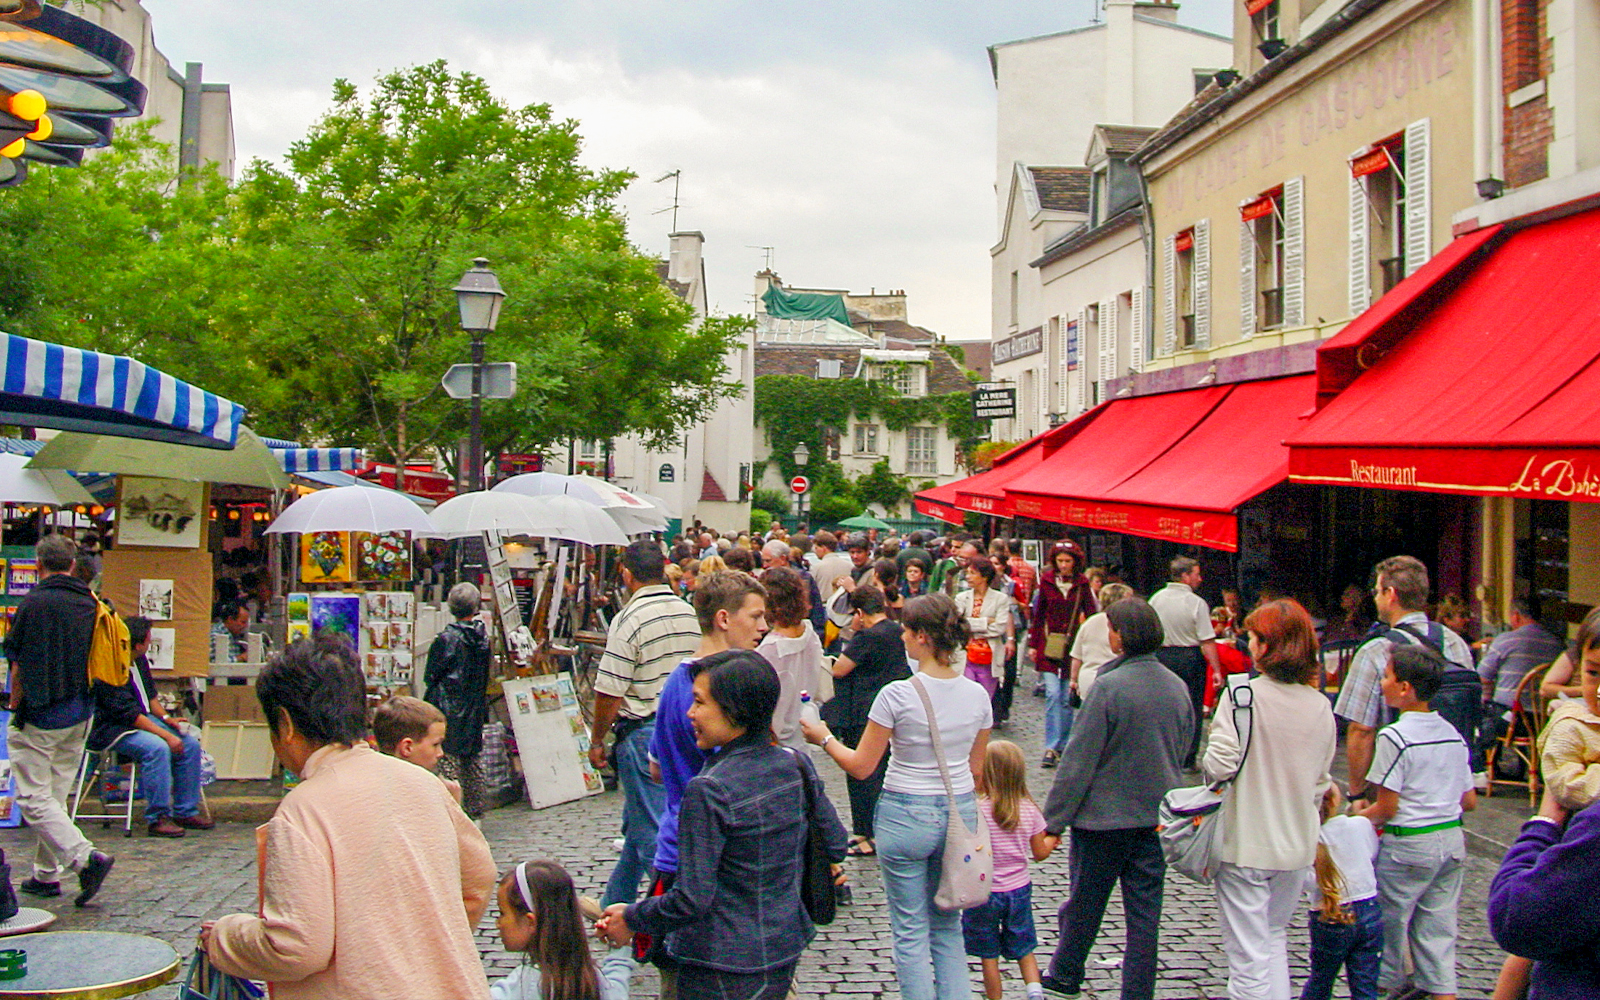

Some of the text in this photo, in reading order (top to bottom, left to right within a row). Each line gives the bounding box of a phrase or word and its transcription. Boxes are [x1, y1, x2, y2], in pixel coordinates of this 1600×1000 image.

[1260, 121, 1286, 168] DE
[1299, 20, 1453, 146] GASCOGNE
[1351, 459, 1417, 486] Restaurant
[1509, 454, 1600, 497] La Bohè
